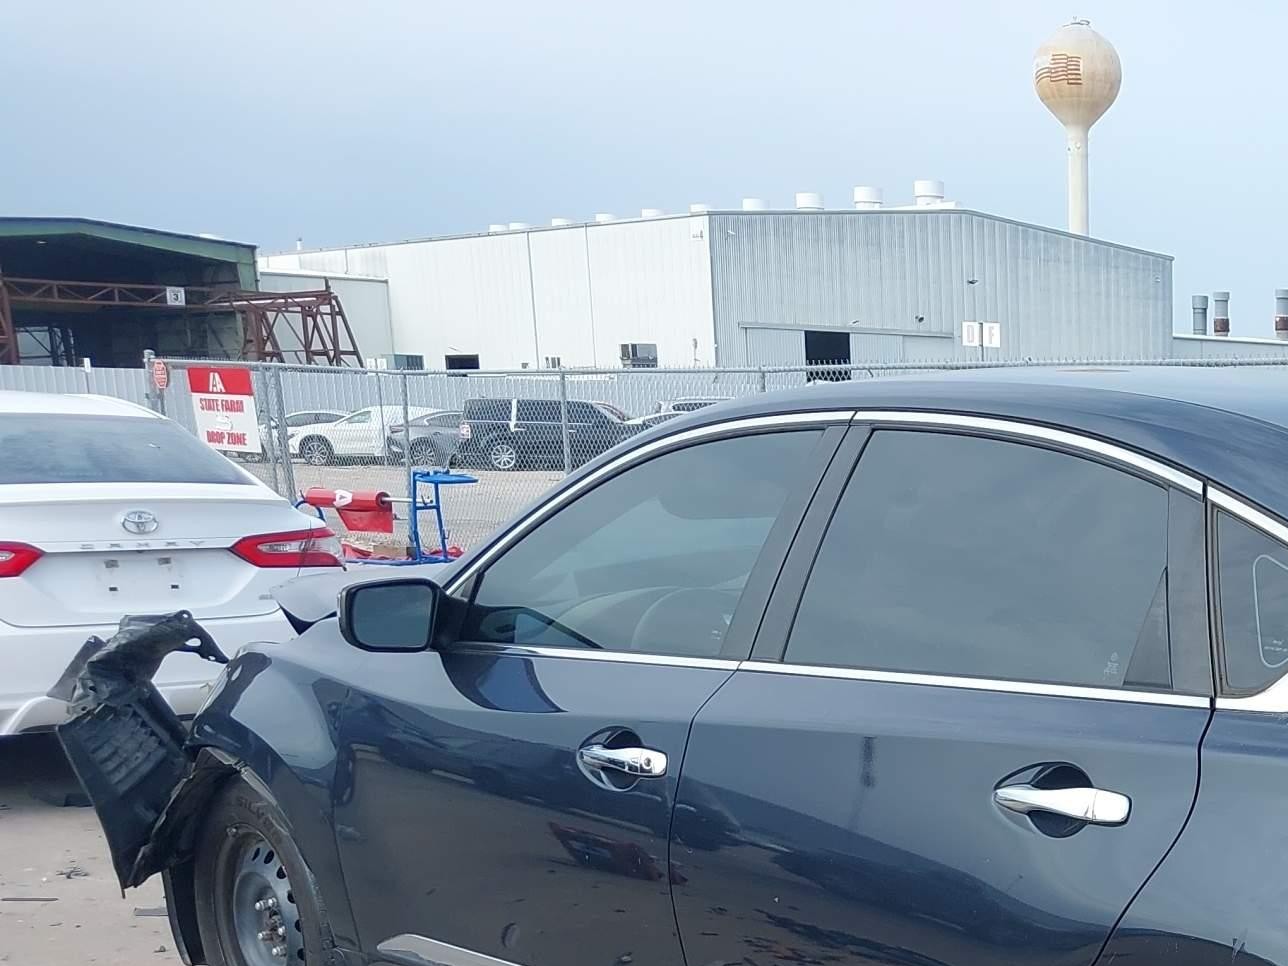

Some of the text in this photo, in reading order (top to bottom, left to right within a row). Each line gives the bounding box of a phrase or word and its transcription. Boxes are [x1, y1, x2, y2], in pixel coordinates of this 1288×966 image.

[200, 398, 244, 412] STATE FARM
[206, 430, 248, 446] DROP ZONE
